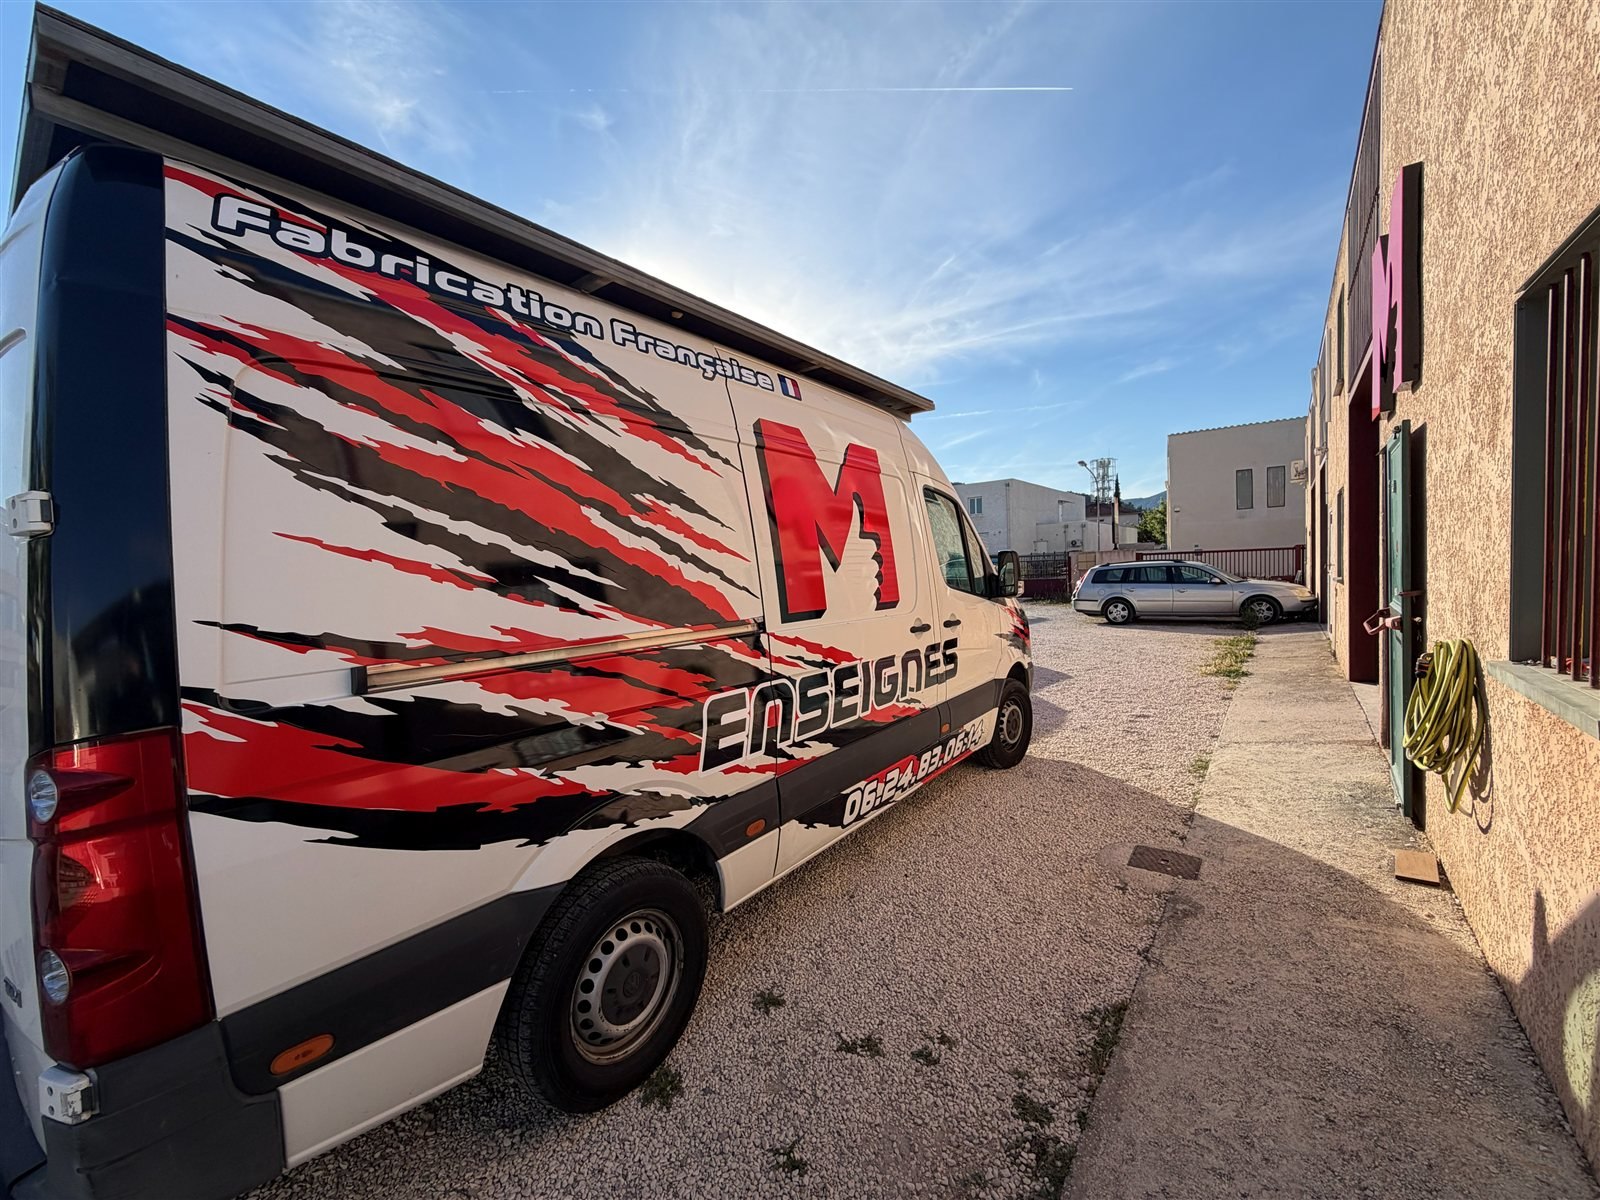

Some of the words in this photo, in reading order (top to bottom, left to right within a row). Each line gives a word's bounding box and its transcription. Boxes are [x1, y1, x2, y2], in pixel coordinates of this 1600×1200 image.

[213, 195, 603, 338] Fabrication
[611, 319, 774, 391] Française
[753, 418, 900, 624] M
